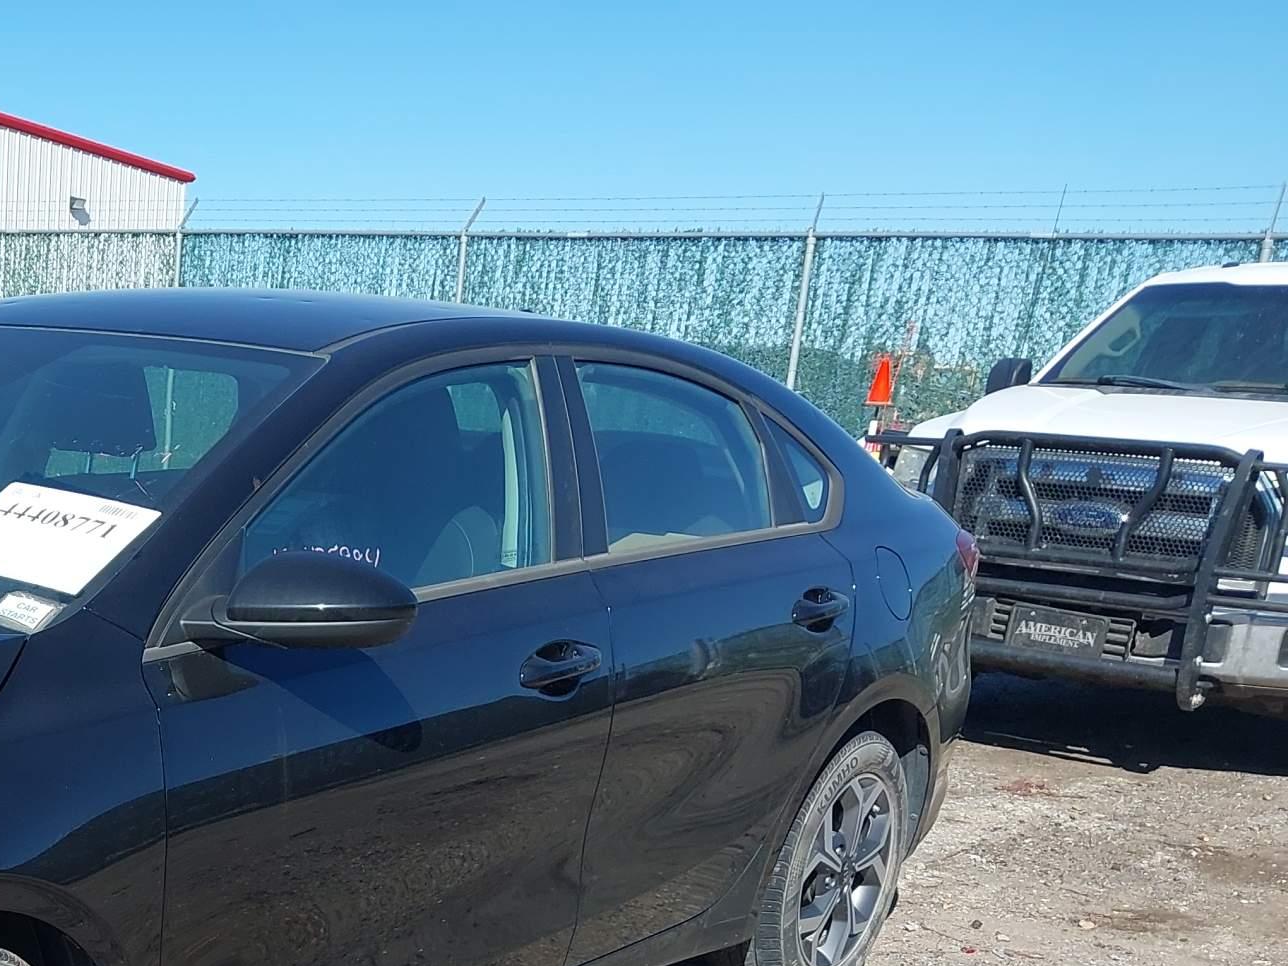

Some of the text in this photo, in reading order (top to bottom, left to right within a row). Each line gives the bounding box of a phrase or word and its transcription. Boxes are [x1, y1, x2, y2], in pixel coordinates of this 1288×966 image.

[0, 502, 118, 539] 44408771
[0, 609, 39, 624] STARTS
[16, 601, 39, 613] CAR
[1015, 619, 1097, 648] AMERICAN
[1030, 632, 1080, 649] IMPLEMENT
[816, 756, 859, 815] KUMHO
